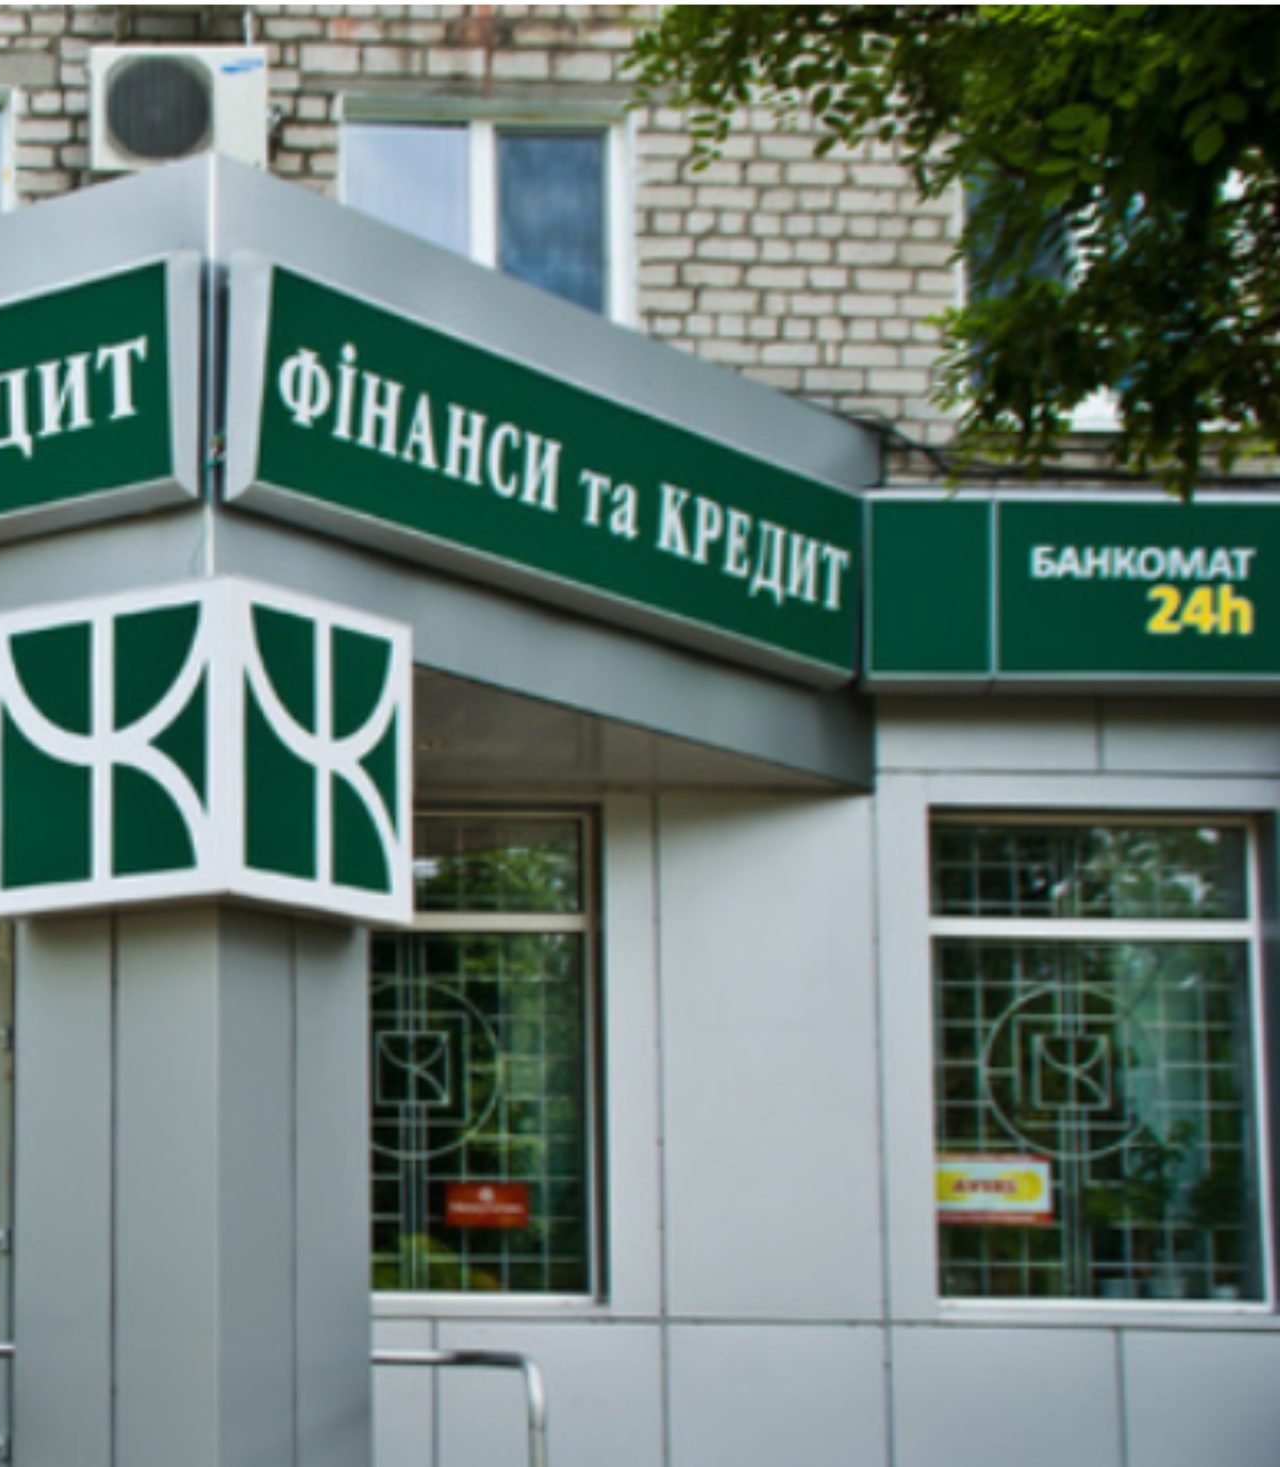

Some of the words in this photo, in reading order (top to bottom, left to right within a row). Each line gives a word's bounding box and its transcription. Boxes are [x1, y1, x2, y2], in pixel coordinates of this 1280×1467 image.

[578, 468, 639, 541] та
[656, 481, 851, 611] КРЕДИТ
[1030, 545, 1256, 580] БАНКОМАТ
[1146, 583, 1254, 635] 24h
